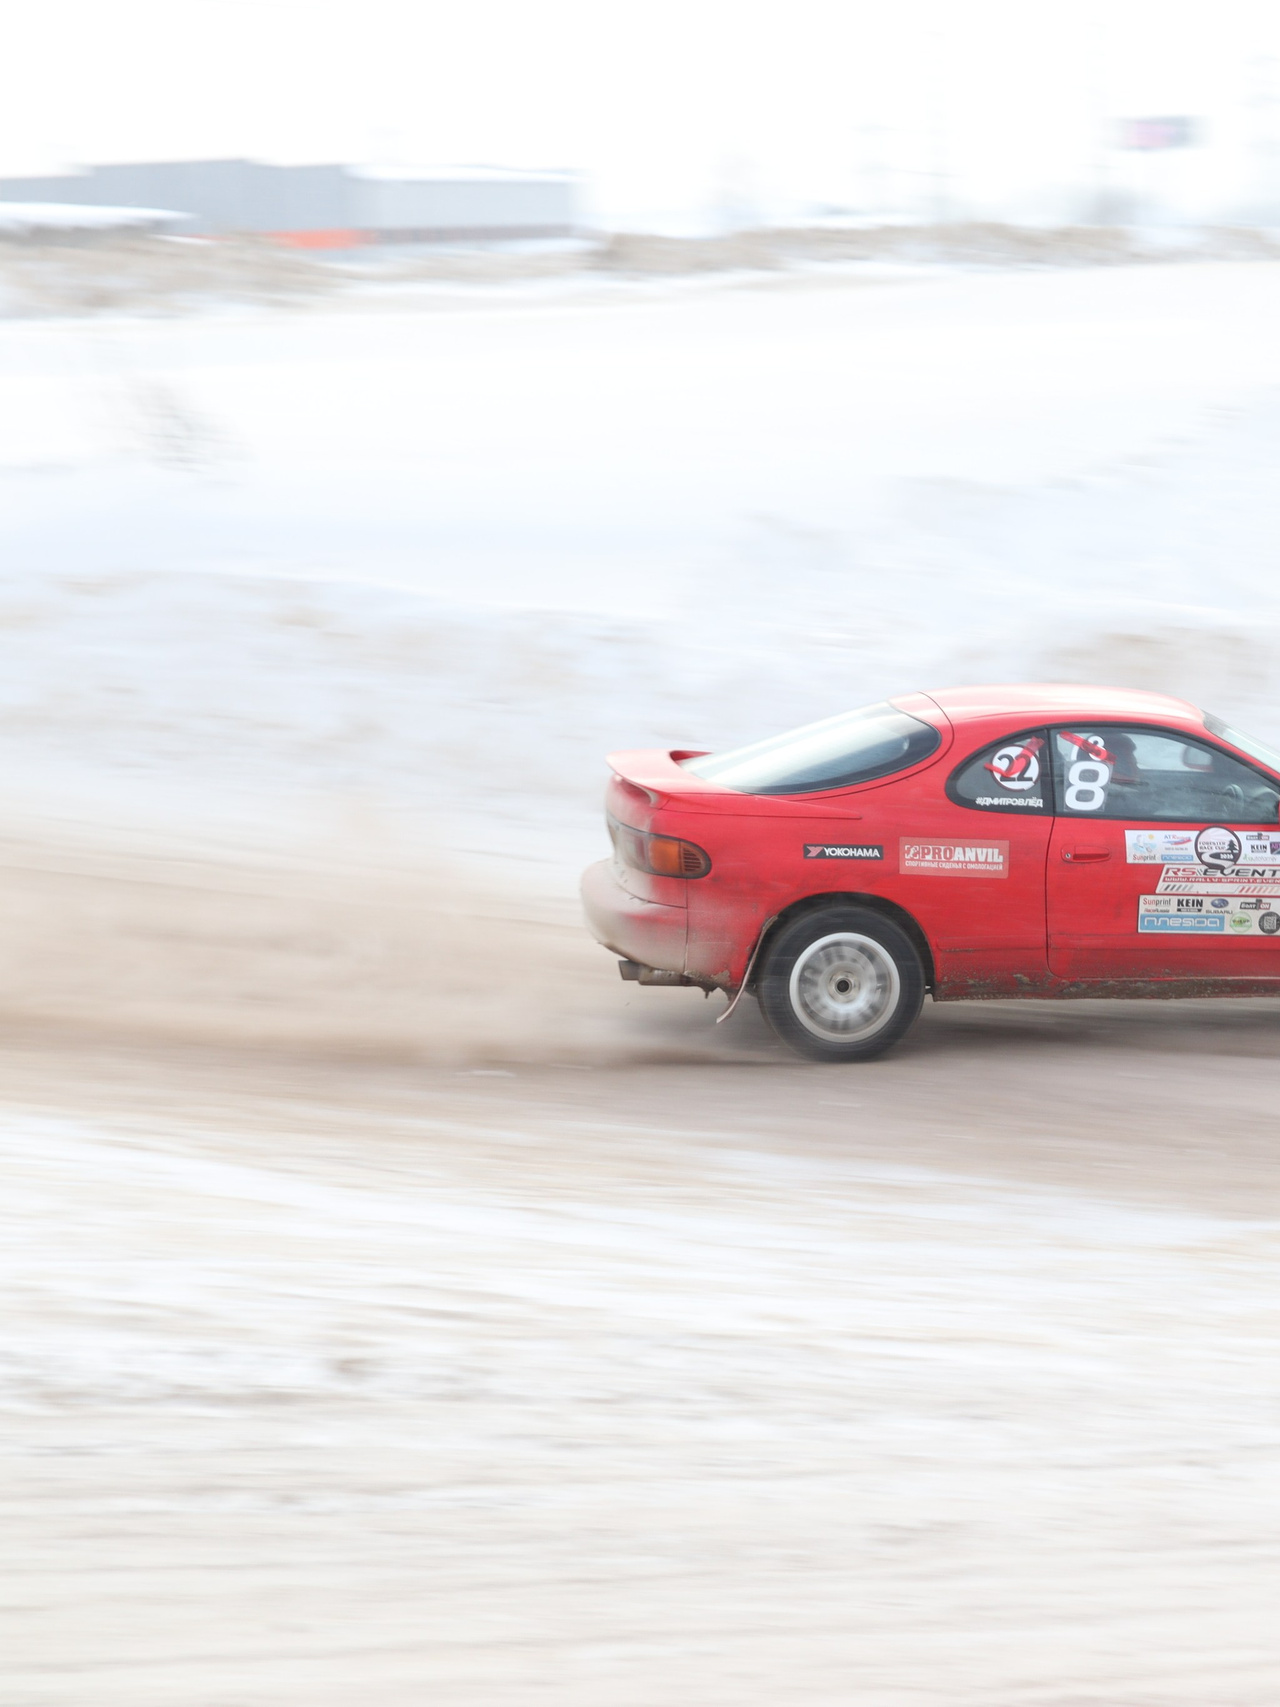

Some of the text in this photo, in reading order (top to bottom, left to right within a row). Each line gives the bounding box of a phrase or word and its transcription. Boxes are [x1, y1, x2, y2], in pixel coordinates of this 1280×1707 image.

[997, 753, 1033, 782] 22
[1065, 761, 1109, 810] 8
[824, 847, 881, 858] YOKOHAMA
[921, 845, 1003, 863] PROANVIL
[1133, 854, 1156, 862] Sunprint
[905, 860, 938, 868] СПОРТИВНЫЕ
[938, 861, 962, 869] СИДЕНЬЯ
[1143, 897, 1171, 907] Sunprint
[1177, 898, 1203, 907] KEIN
